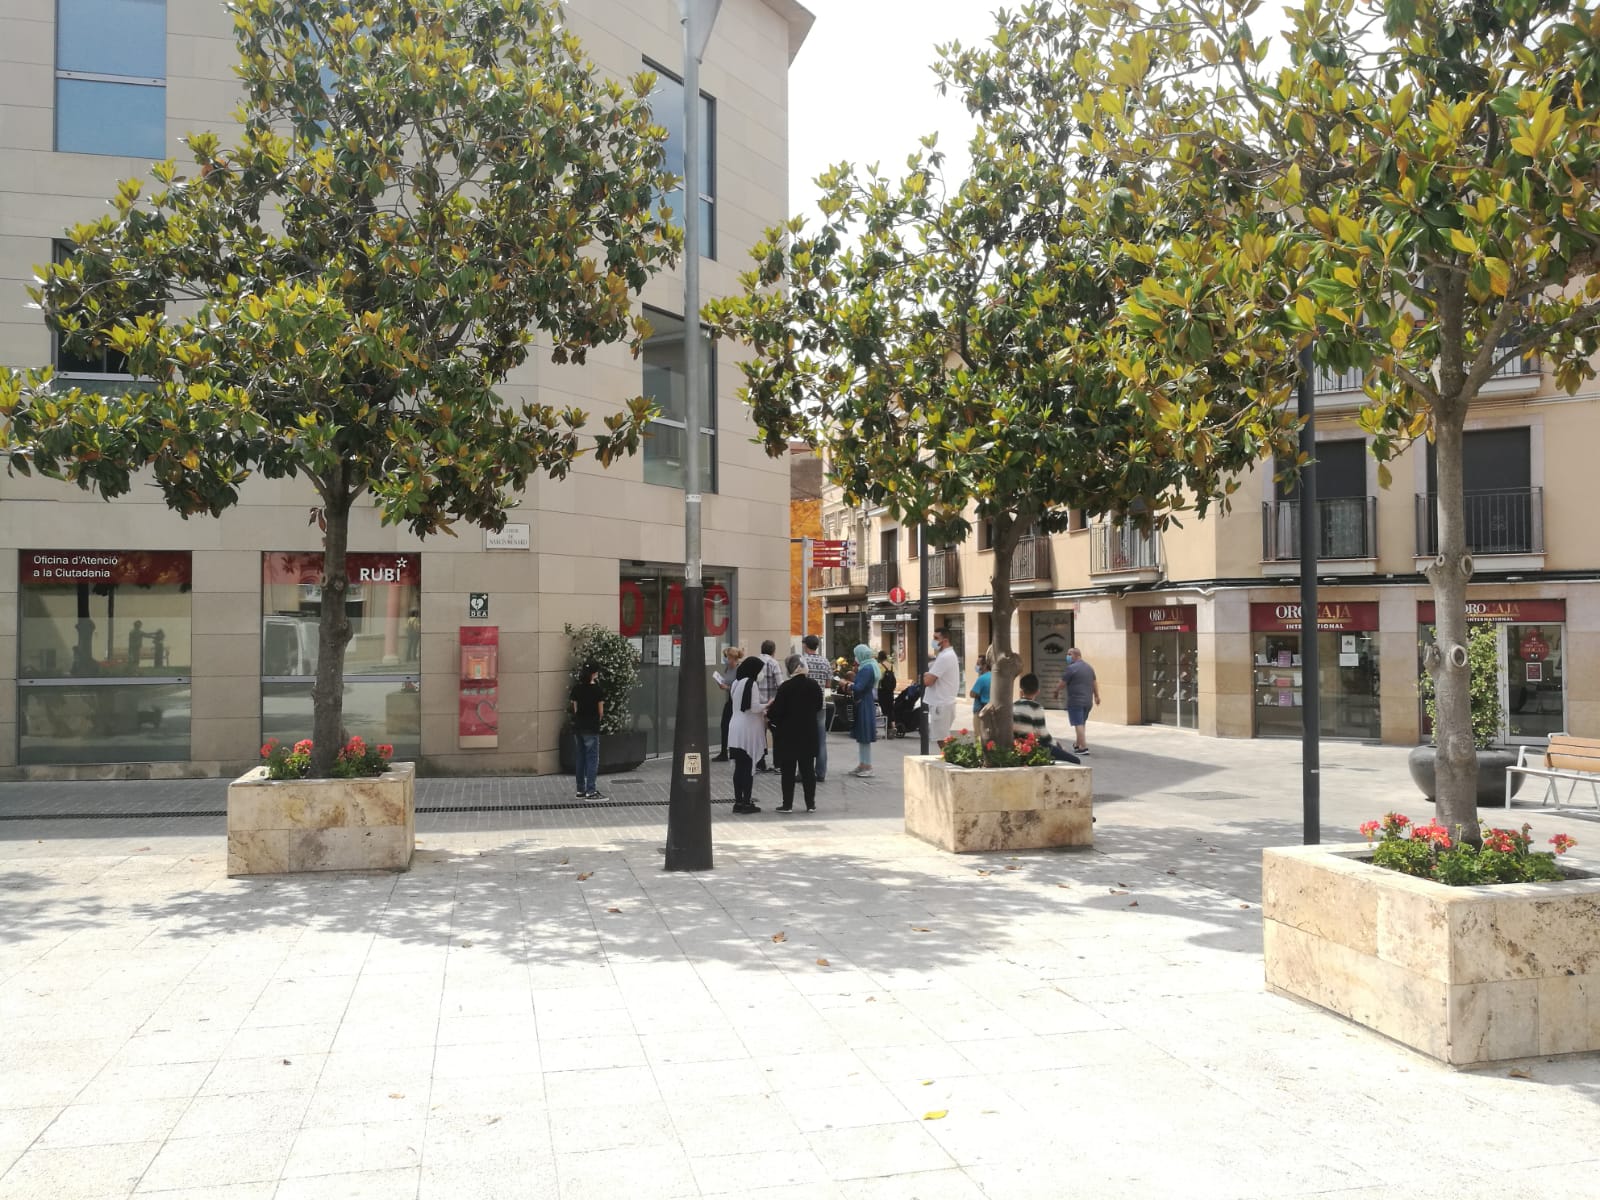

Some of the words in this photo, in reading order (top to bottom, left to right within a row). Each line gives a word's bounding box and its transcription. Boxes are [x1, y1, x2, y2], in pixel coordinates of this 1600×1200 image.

[33, 555, 69, 565] Oficina
[71, 555, 118, 565] d'Atenció
[33, 569, 40, 577] a
[43, 568, 52, 577] la
[55, 568, 110, 578] Ciutadania
